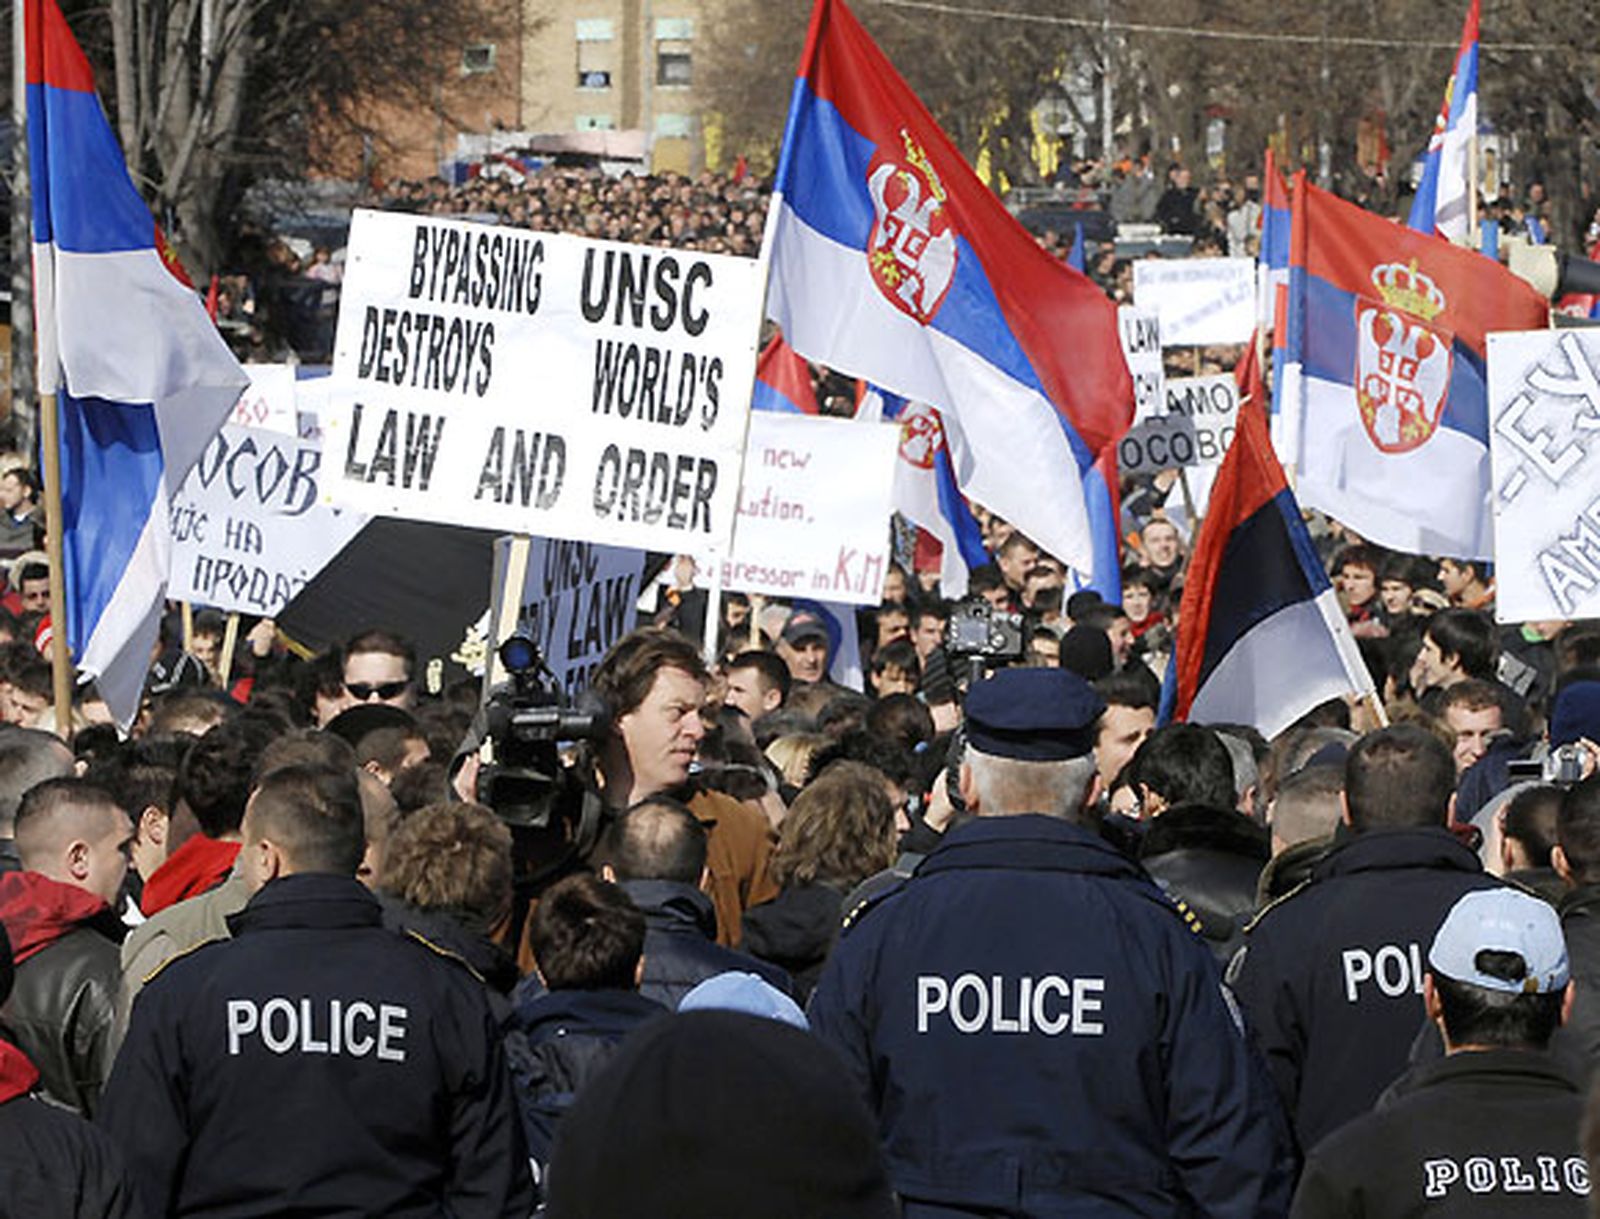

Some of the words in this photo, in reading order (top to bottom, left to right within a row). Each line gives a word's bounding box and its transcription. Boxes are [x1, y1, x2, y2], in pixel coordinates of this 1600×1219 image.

[408, 225, 545, 315] BYPASSING
[580, 247, 713, 337] UNSC
[358, 305, 495, 398] DESTROYS
[591, 338, 723, 431] WORLD'S
[343, 403, 445, 491] LAW
[474, 426, 567, 510] AND
[593, 443, 719, 534] ORDER
[762, 447, 812, 469] new
[225, 517, 262, 555] НА
[694, 562, 805, 588] gressor
[567, 573, 634, 660] LAW
[1342, 943, 1424, 1002] POL
[227, 997, 408, 1061] POLICE
[917, 973, 1105, 1035] POLICE
[1424, 1157, 1592, 1198] POLIC
